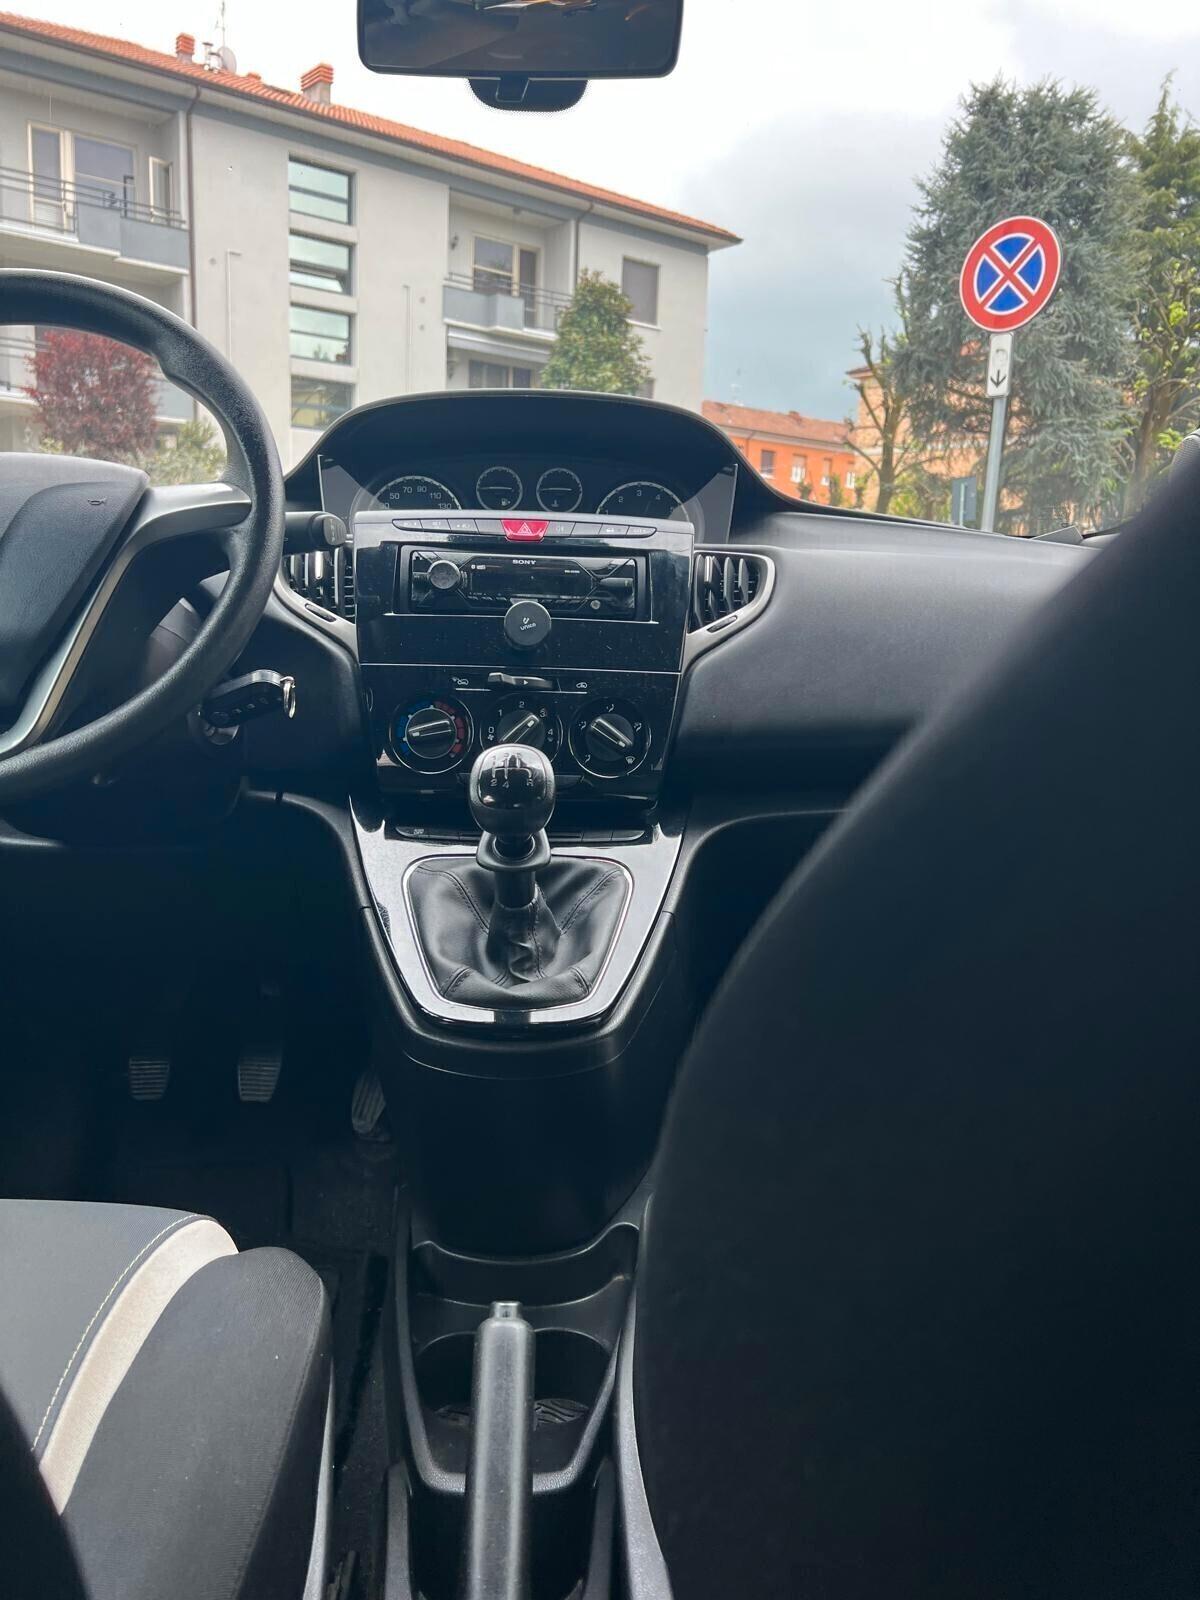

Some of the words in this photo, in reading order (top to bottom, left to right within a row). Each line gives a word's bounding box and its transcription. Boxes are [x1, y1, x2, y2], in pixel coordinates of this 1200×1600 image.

[403, 486, 413, 494] 70
[389, 492, 400, 500] 50
[518, 700, 525, 709] 2
[540, 707, 546, 718] 3
[547, 728, 554, 736] 4
[490, 778, 498, 787] 2
[502, 780, 510, 788] 4
